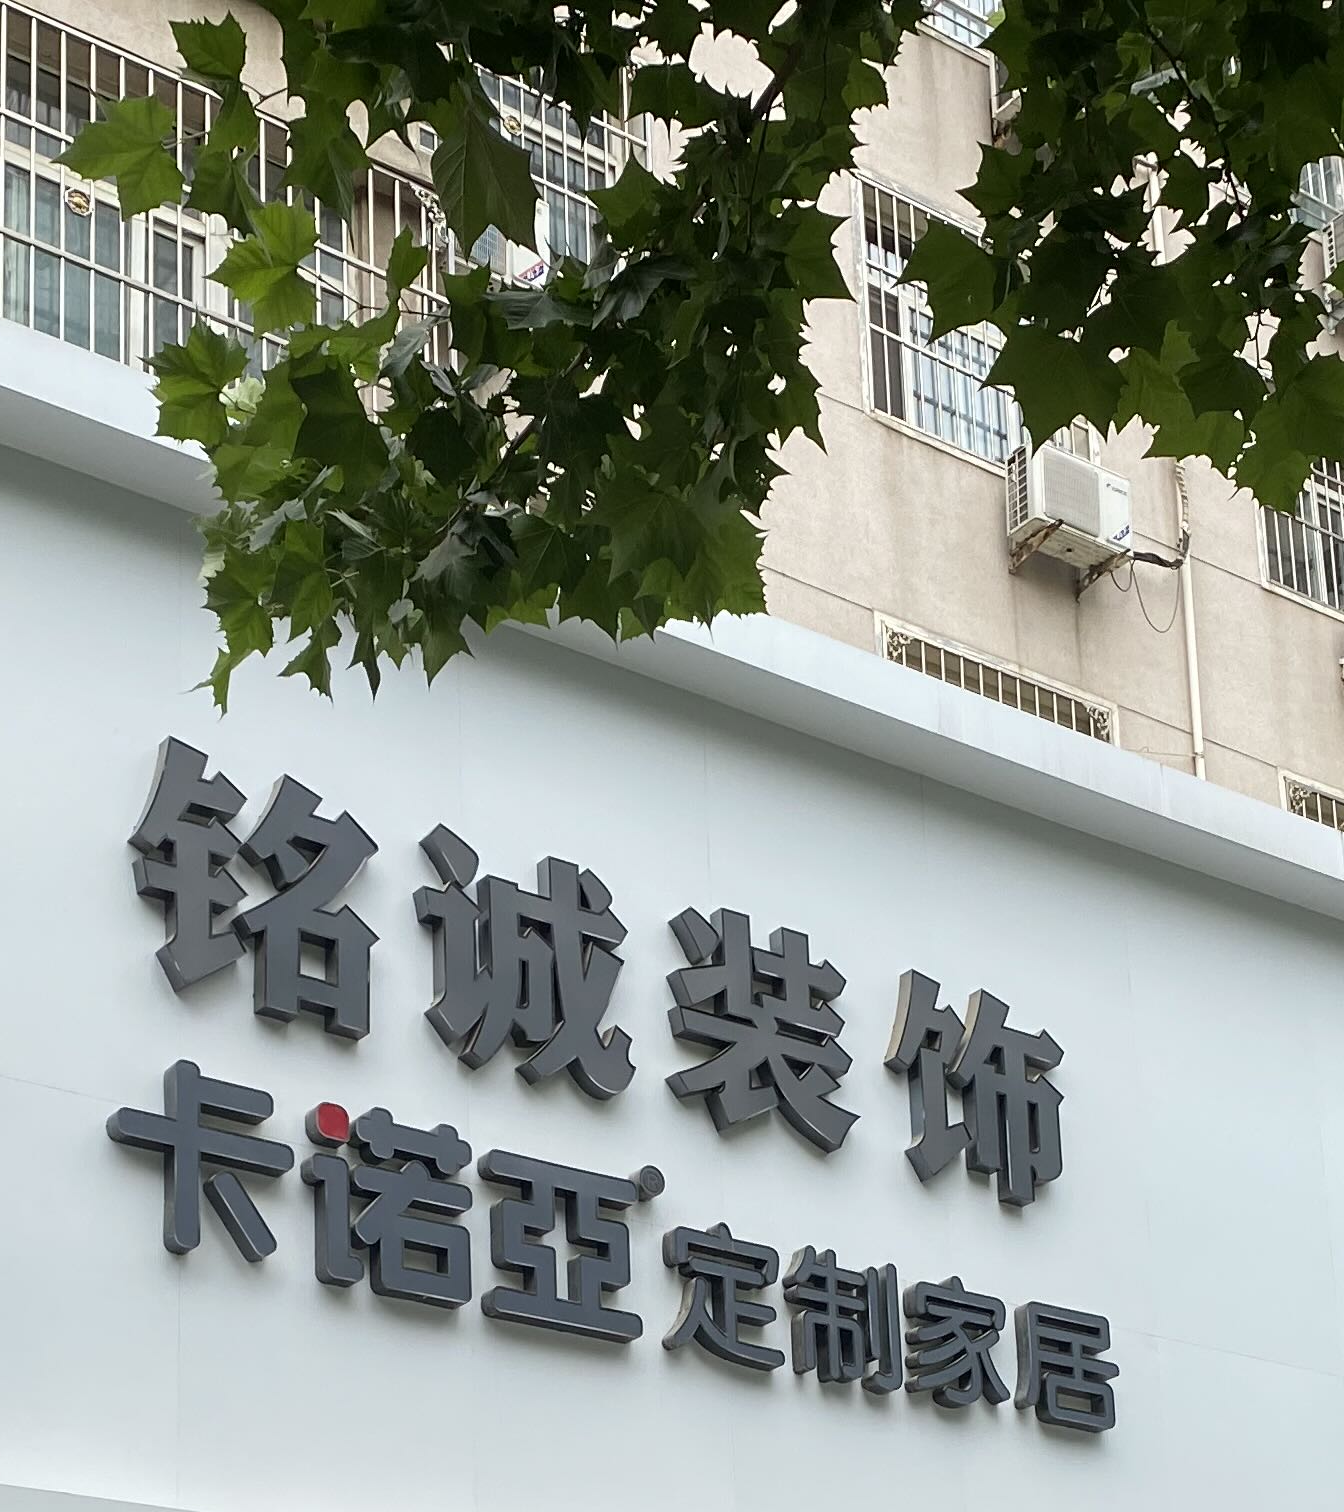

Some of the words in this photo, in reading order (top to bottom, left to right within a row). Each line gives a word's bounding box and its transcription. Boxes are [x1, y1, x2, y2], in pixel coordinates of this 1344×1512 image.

[128, 736, 1065, 1207] 铭诚装饰
[662, 1221, 1120, 1433] 定制家居
